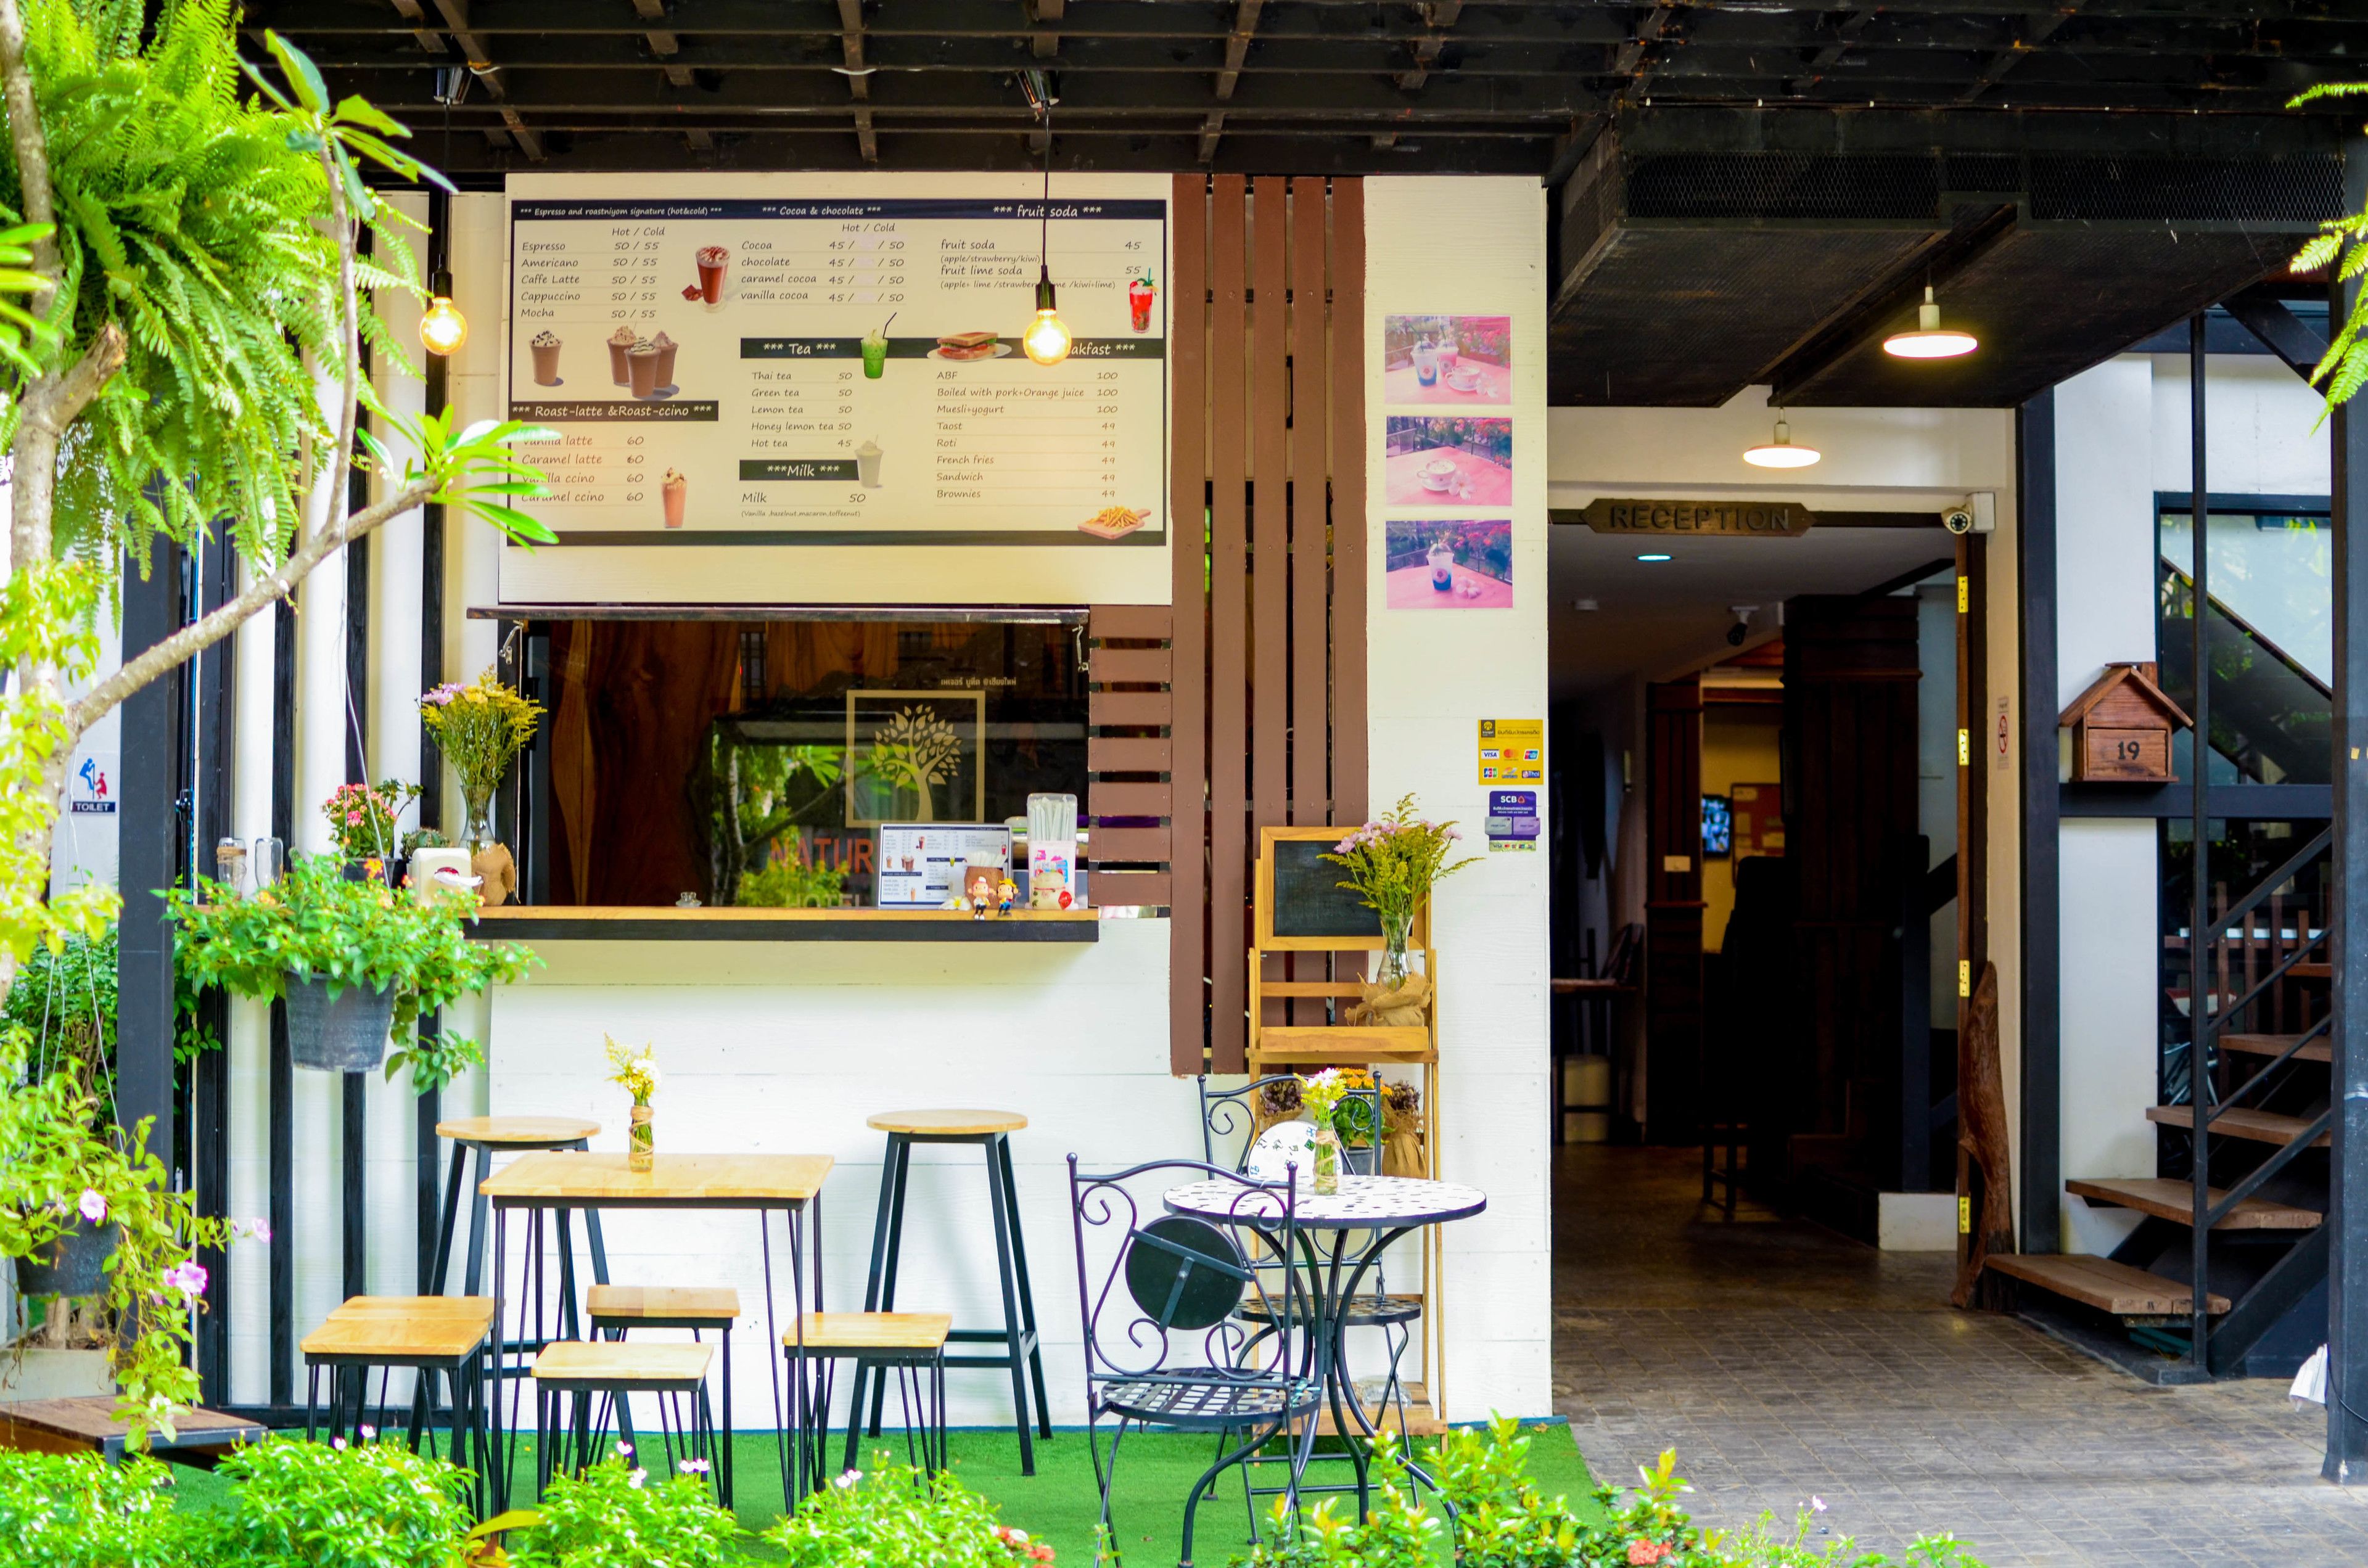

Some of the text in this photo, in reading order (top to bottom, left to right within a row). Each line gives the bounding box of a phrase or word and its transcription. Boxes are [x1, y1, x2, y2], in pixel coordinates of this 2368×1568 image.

[585, 208, 627, 216] roastniyom
[667, 208, 708, 216] (hot&cold)
[780, 207, 863, 215] Cocoa & chocolate
[1018, 205, 1078, 217] fruit soda
[612, 228, 630, 236] Hot
[644, 227, 665, 236] Cold
[842, 223, 860, 232] Hot
[874, 223, 895, 232] Cold
[522, 242, 565, 253] Espresso
[615, 242, 629, 250] 50
[644, 242, 659, 250] 55
[742, 241, 772, 250] Cocoa
[829, 241, 845, 250] 45
[889, 241, 904, 250] 50
[941, 240, 1141, 250] fruit soda 45
[522, 258, 578, 267] Americano
[613, 258, 628, 266] 50
[643, 258, 658, 266] 55
[741, 258, 790, 266] chocolate
[829, 258, 844, 267] 45
[889, 258, 904, 267] 50
[940, 255, 1041, 264] (apple/strawberry/kiwi)
[941, 266, 966, 275] fruit
[970, 266, 993, 275] lime
[997, 266, 1022, 275] soda
[522, 274, 547, 284] Caffe
[553, 276, 580, 284] Latte
[612, 276, 627, 284] 50
[642, 276, 657, 284] 55
[741, 274, 784, 283] caramel
[829, 276, 844, 284] 45
[889, 276, 904, 284] 50
[1069, 281, 1116, 289] /kiwi+lime)
[521, 291, 580, 303] Cappuccino
[612, 292, 626, 301] 50
[641, 292, 656, 301] 55
[741, 290, 775, 300] vanilla
[829, 293, 844, 302] 45
[889, 293, 904, 302] 50
[521, 309, 554, 317] Mocha
[611, 310, 626, 318] 50
[641, 310, 655, 318] 55
[789, 344, 811, 355] Tea
[752, 372, 773, 380] Thai
[937, 371, 1117, 380] ABF 100
[752, 388, 780, 396] Green
[937, 388, 966, 396] Boiled
[971, 388, 992, 396] with
[995, 388, 1059, 399] pork+Orange
[1063, 388, 1084, 399] juice
[535, 406, 688, 416] Roast-latte &Roast-ccino
[838, 406, 852, 414] 50
[937, 405, 1004, 416] Muesli+yogurt
[752, 423, 782, 432] Honey
[566, 435, 593, 445] latte
[627, 437, 644, 445] 60
[937, 439, 1116, 448] Roti 49
[522, 454, 644, 464] Caramel latte 60
[937, 456, 969, 464] French
[973, 456, 994, 464] fries
[787, 464, 815, 477] Milk
[565, 472, 595, 483] ccino
[627, 474, 643, 482] 60
[937, 472, 983, 481] Sandwich
[574, 492, 604, 502] ccino
[627, 493, 643, 501] 60
[742, 493, 866, 503] Milk 50
[937, 490, 981, 498] Brownies
[1610, 506, 1789, 530] RECEPTION
[2118, 741, 2140, 760] 19
[76, 803, 110, 811] TOILET
[771, 837, 881, 874] NATUR
